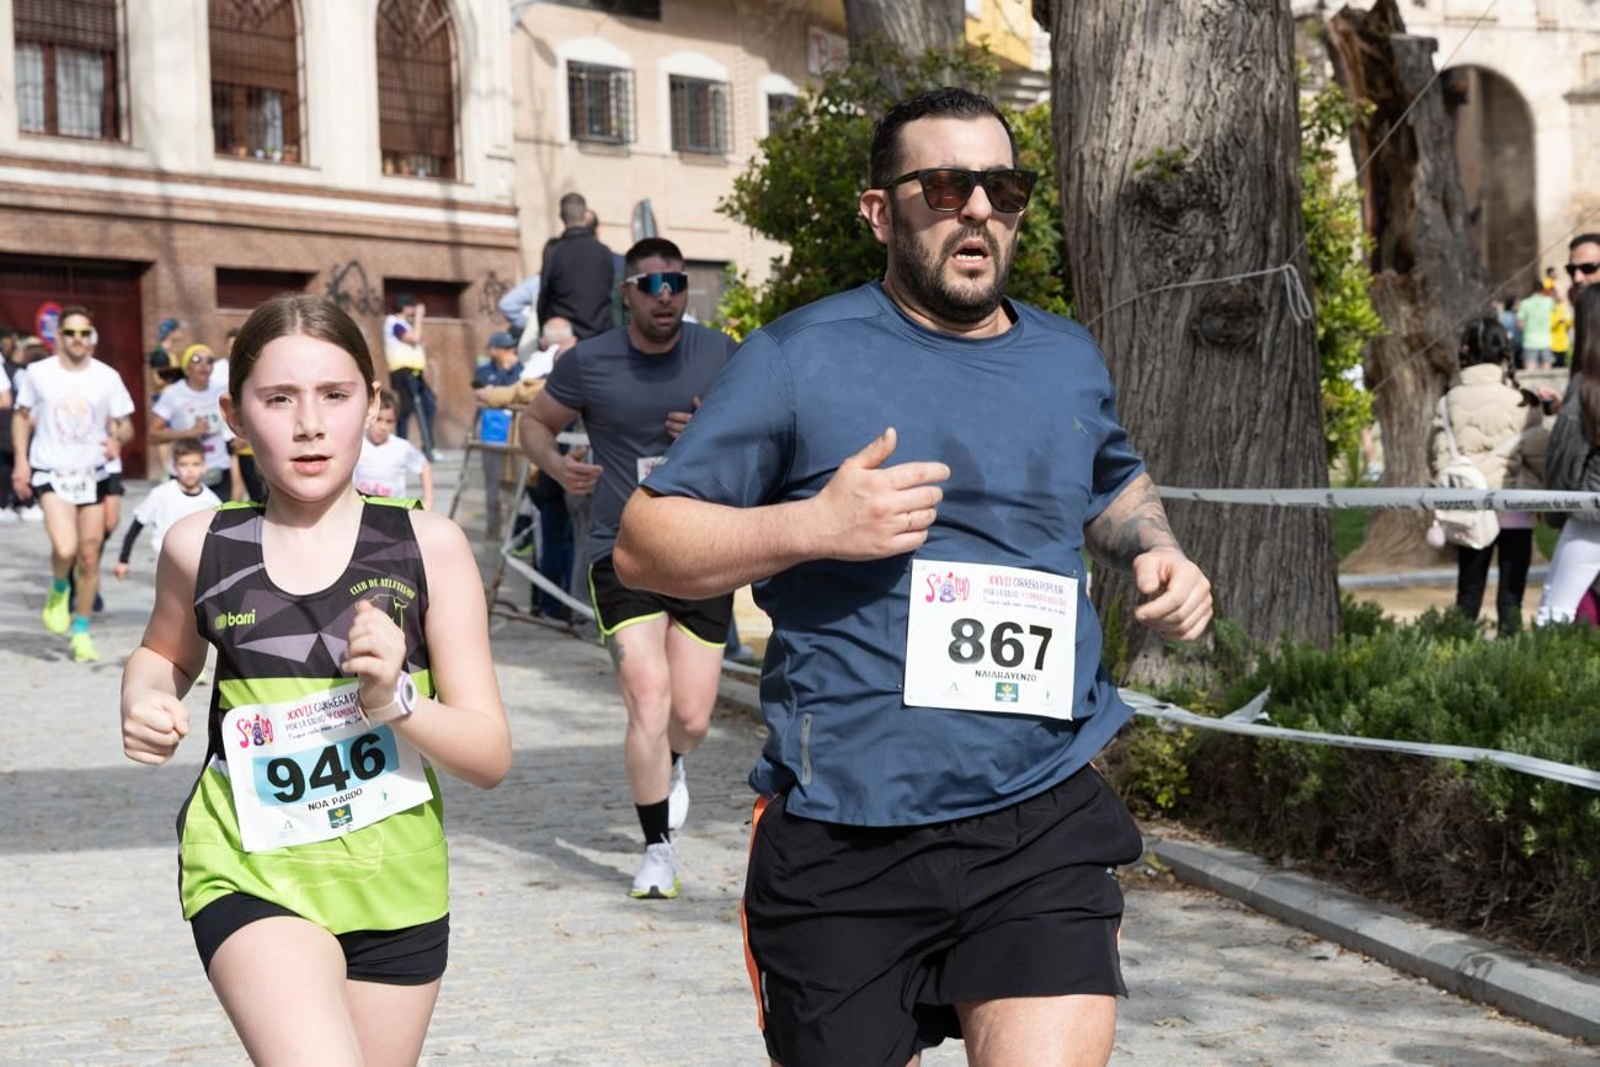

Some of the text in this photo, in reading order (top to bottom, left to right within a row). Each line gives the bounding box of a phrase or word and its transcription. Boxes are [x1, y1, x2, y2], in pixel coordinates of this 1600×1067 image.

[350, 578, 416, 600] CLUB DE ATLETISMO
[228, 609, 256, 627] barri
[948, 617, 1053, 671] 867
[974, 670, 1037, 682] NAIARAYENZO
[314, 694, 349, 712] CARRERA
[267, 733, 386, 803] 946
[308, 800, 329, 811] NOA
[331, 787, 363, 806] PARDO
